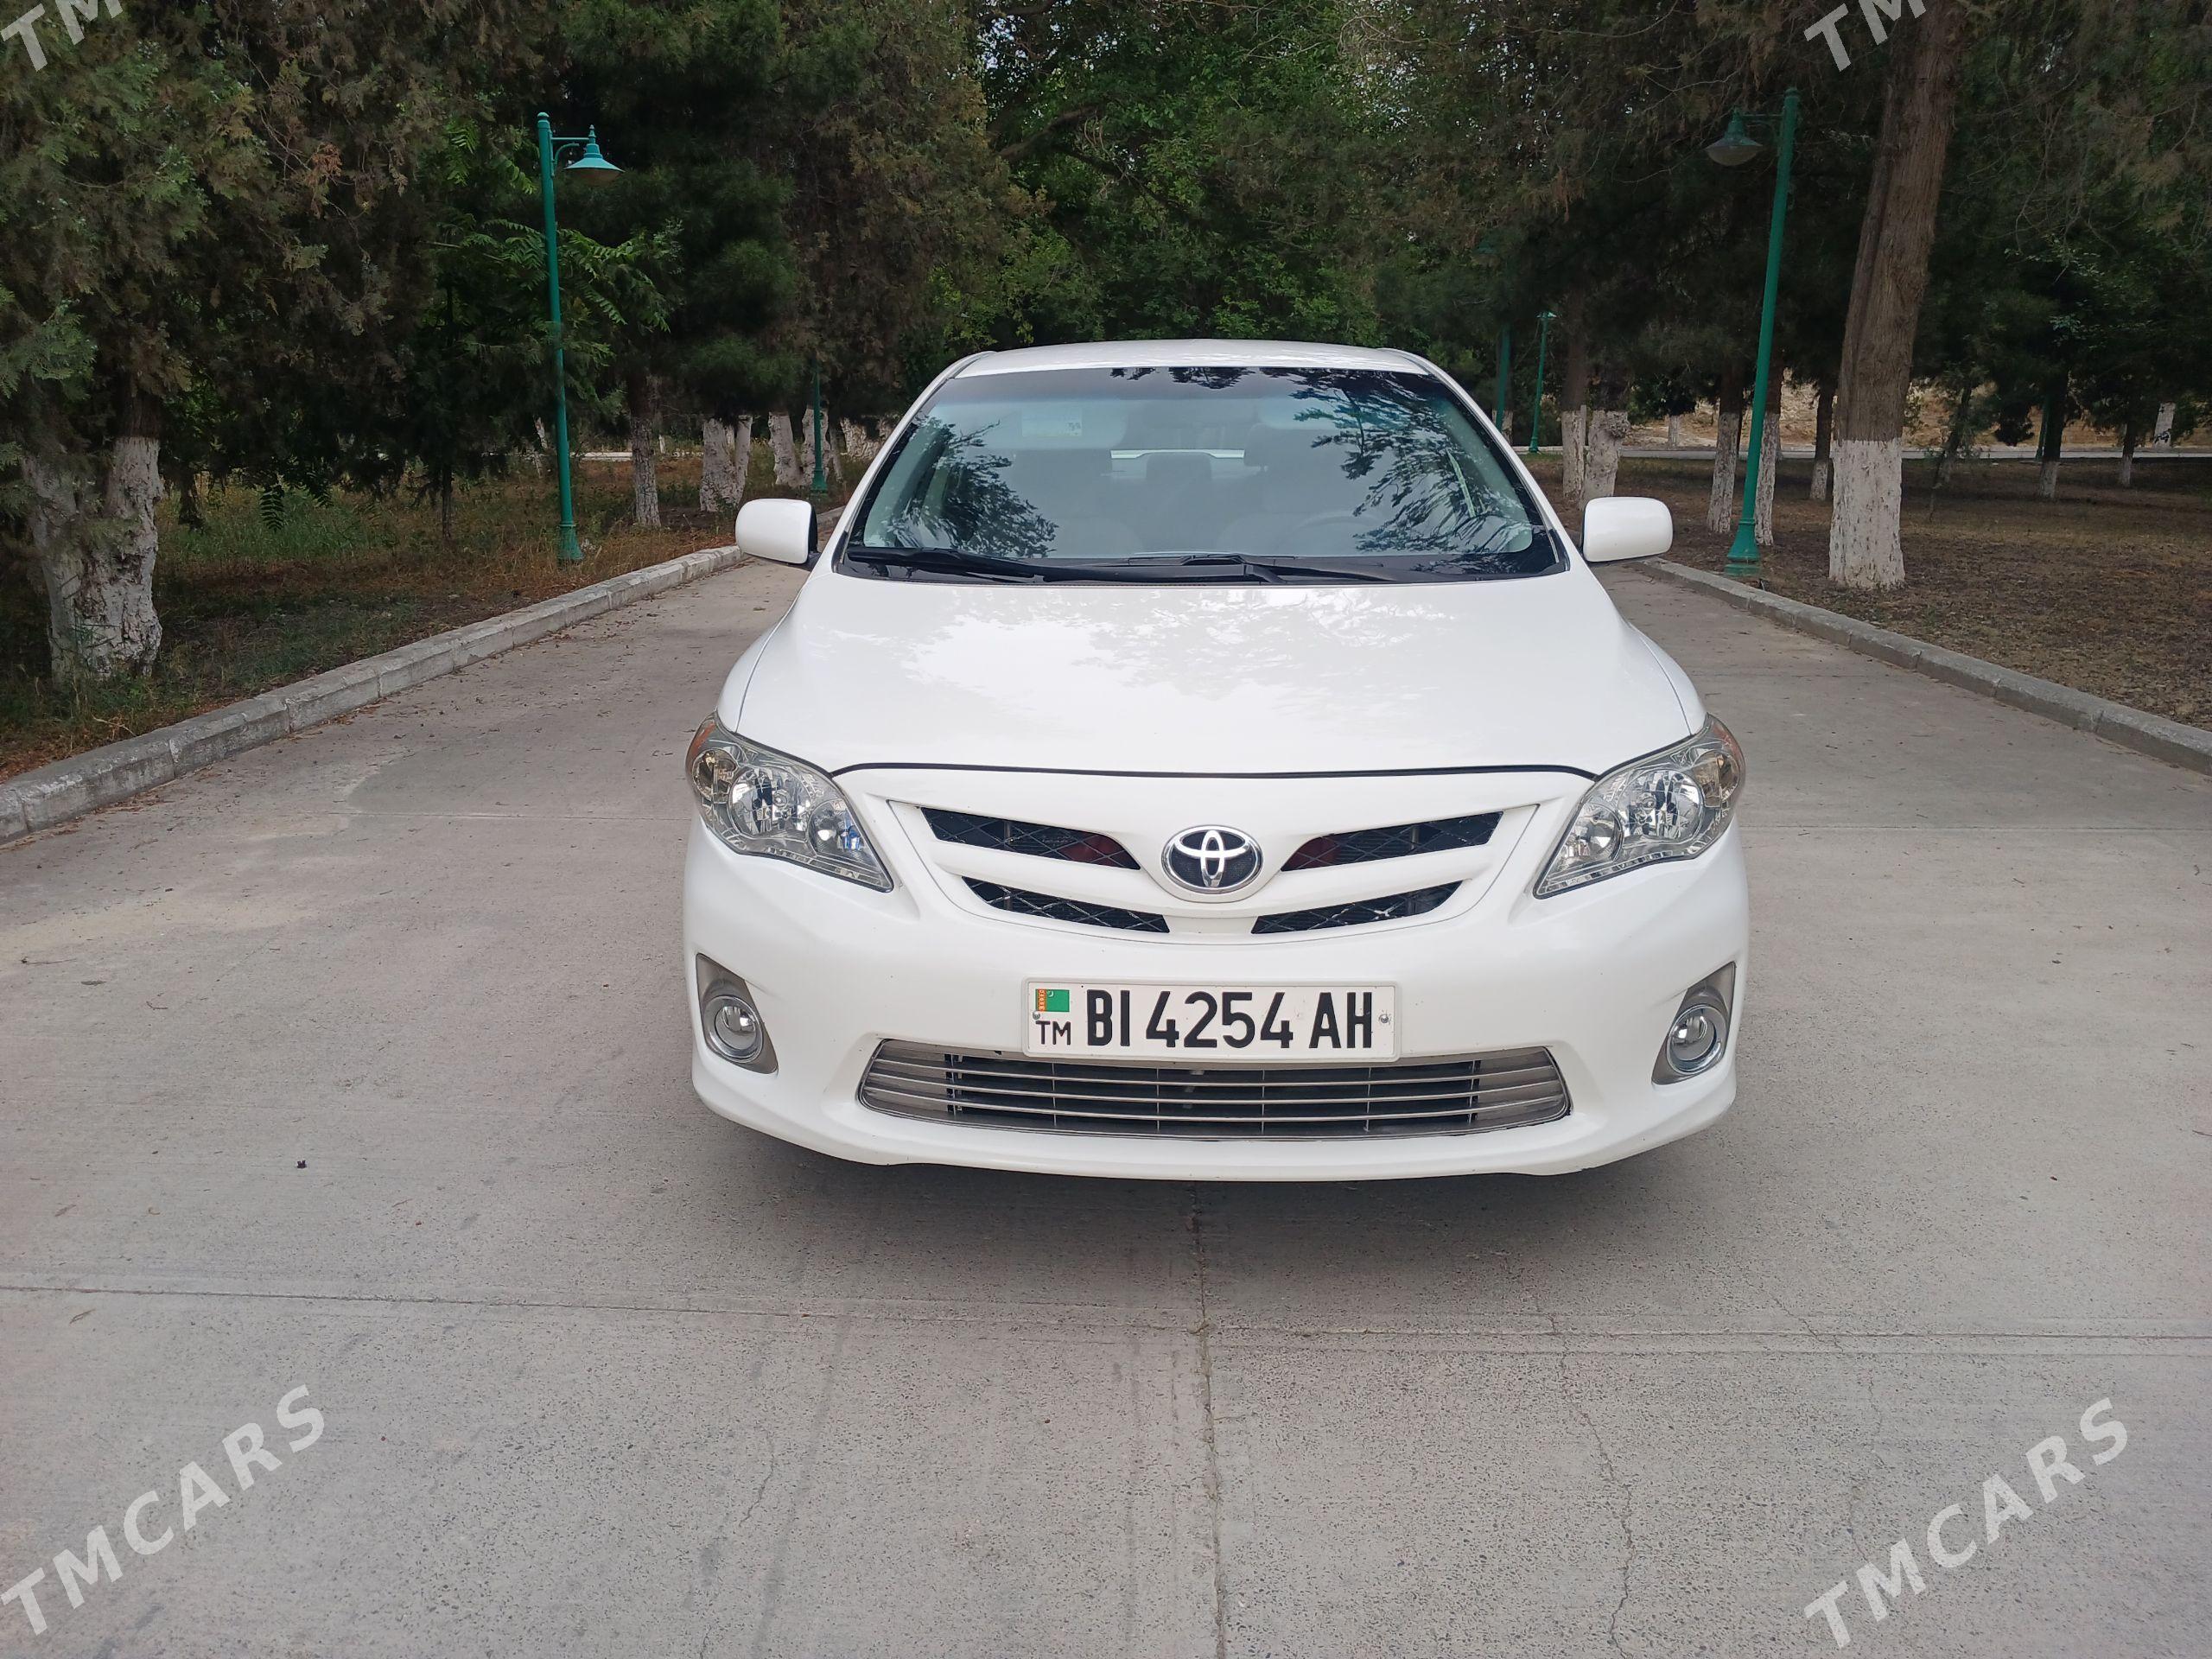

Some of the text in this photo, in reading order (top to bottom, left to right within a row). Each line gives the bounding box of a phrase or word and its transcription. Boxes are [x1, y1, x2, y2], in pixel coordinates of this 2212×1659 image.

[1036, 1020, 1071, 1046] TM
[1086, 988, 1372, 1048] BI 4254 AH
